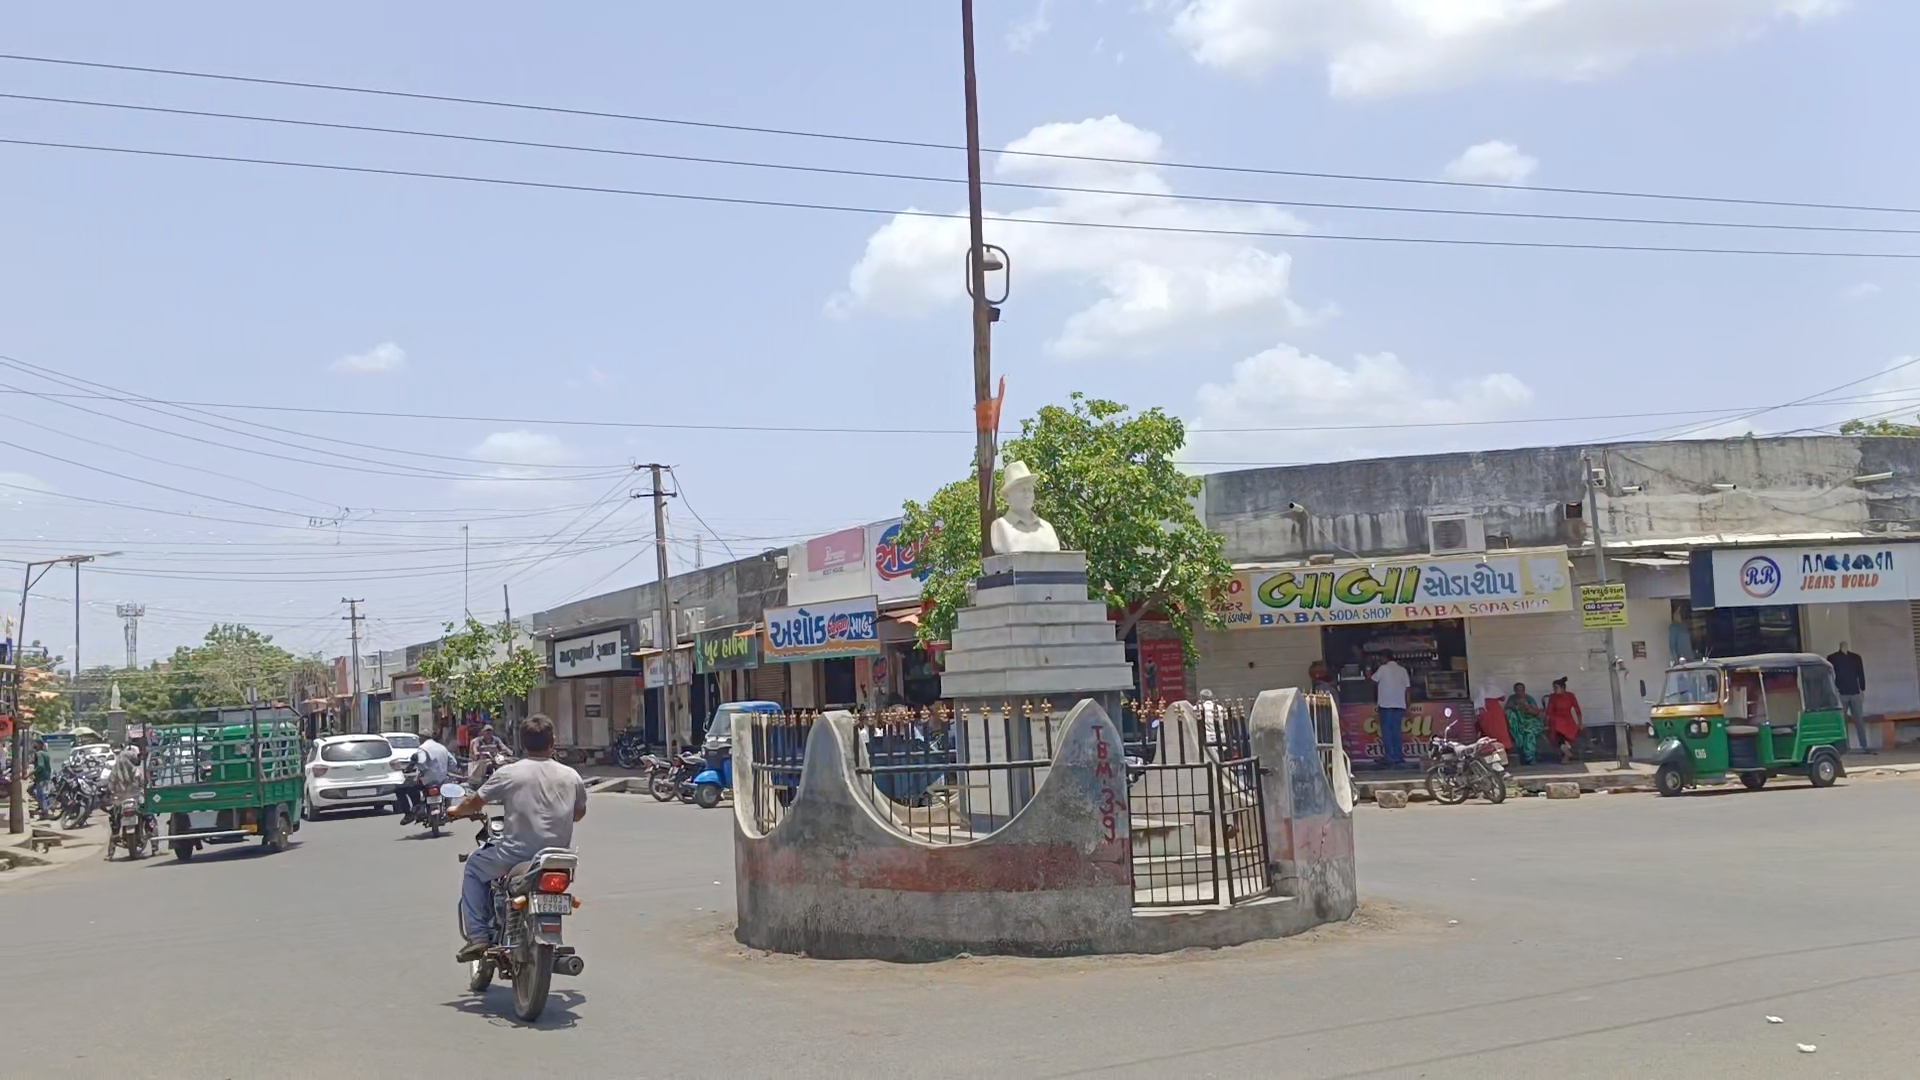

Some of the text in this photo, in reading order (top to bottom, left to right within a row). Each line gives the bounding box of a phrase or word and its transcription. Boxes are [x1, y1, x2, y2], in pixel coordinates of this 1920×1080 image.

[1258, 566, 1422, 609] બાબા
[1800, 573, 1880, 591] JEANS WORLD
[1259, 611, 1326, 625] BABA
[1329, 608, 1360, 621] SODA
[1362, 606, 1392, 620] SHOP
[1404, 604, 1463, 618] BABA
